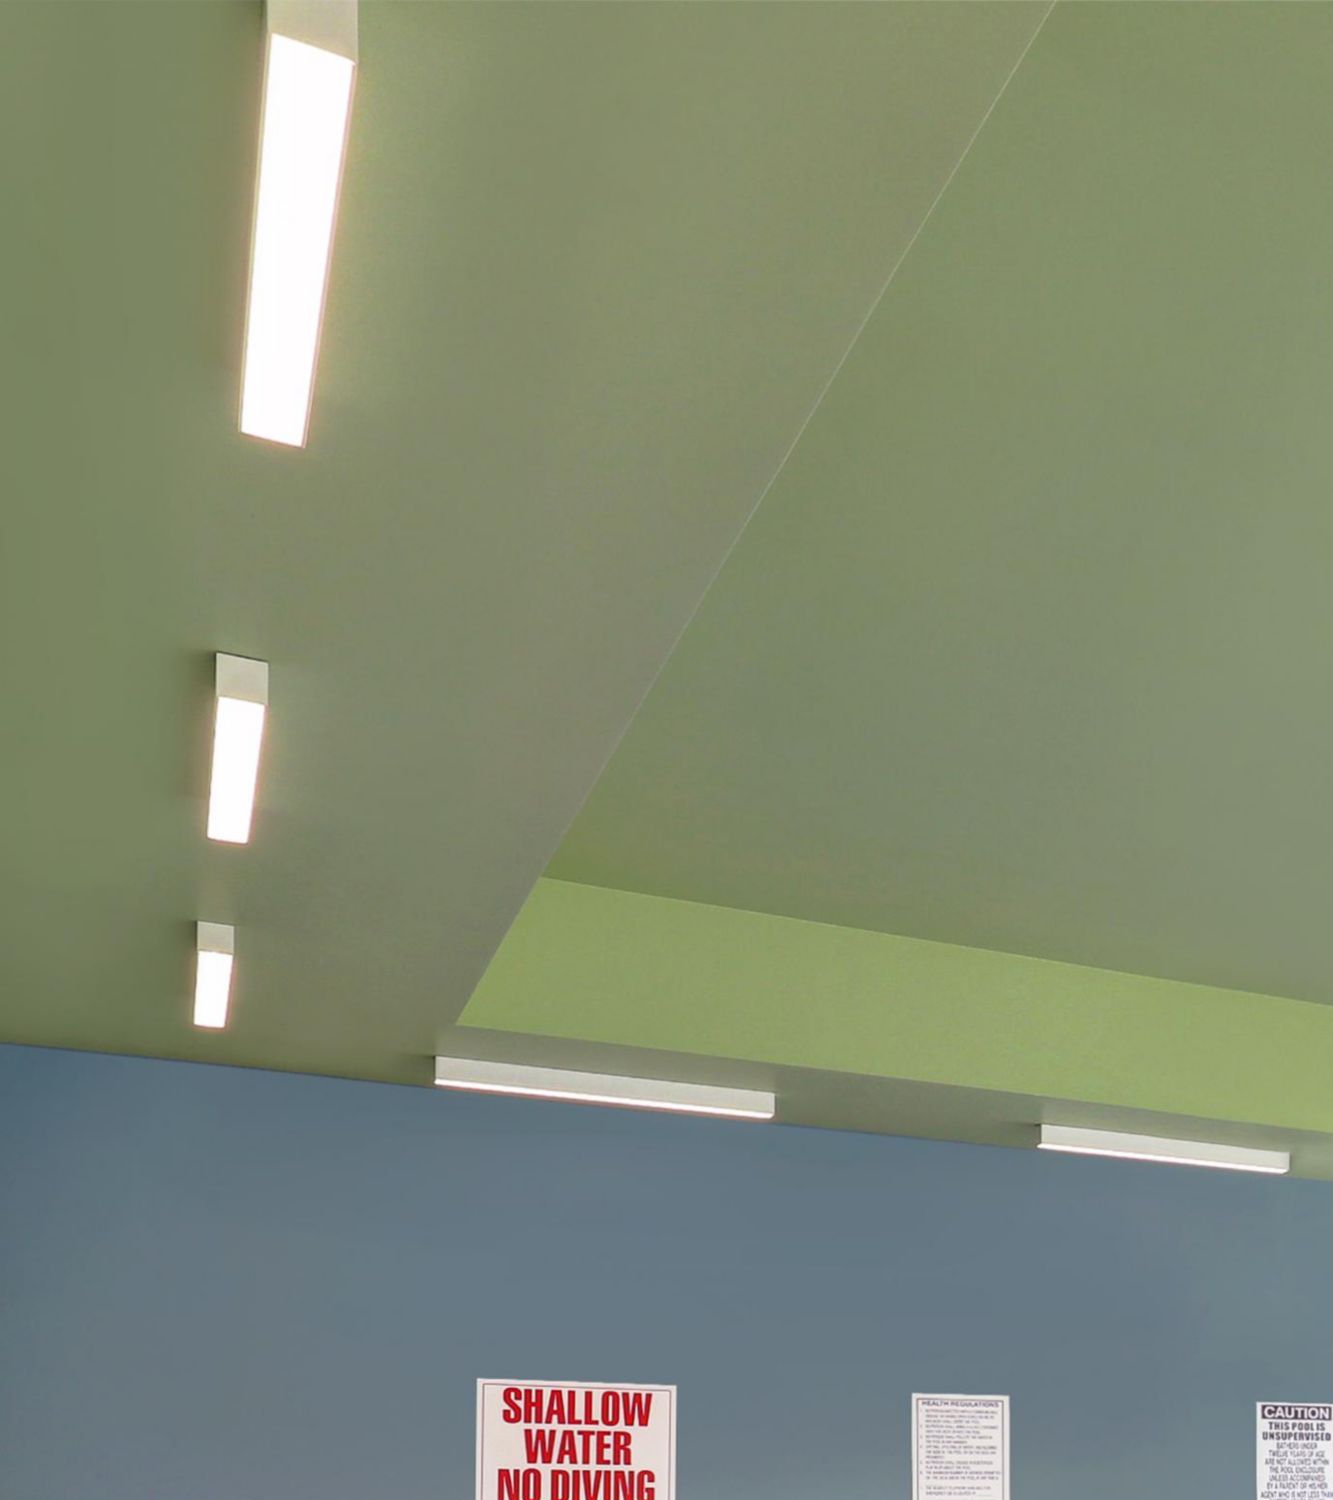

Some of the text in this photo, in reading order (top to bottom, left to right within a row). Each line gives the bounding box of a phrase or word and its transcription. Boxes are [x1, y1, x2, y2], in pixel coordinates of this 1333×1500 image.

[502, 1387, 653, 1427] SHALLOW
[1264, 1406, 1330, 1419] CAUTION
[1268, 1421, 1326, 1431] THIS POOL IS
[1262, 1431, 1332, 1441] UNSUPERVISED
[524, 1429, 632, 1465] WATER
